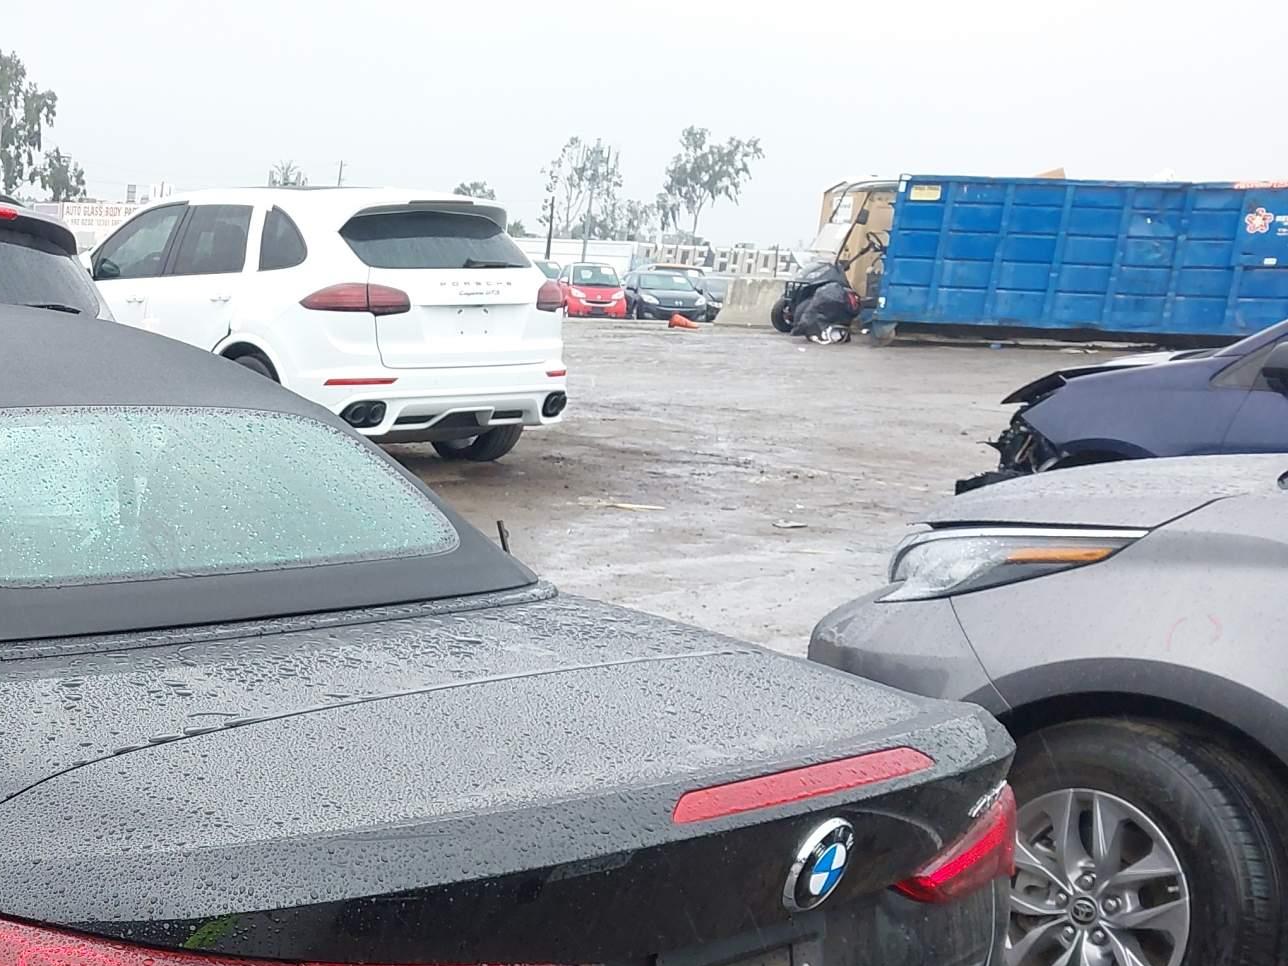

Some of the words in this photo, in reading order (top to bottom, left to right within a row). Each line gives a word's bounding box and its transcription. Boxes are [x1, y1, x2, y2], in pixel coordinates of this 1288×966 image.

[65, 206, 82, 217] AUTO
[83, 206, 103, 217] GLASS
[105, 207, 121, 217] BODY
